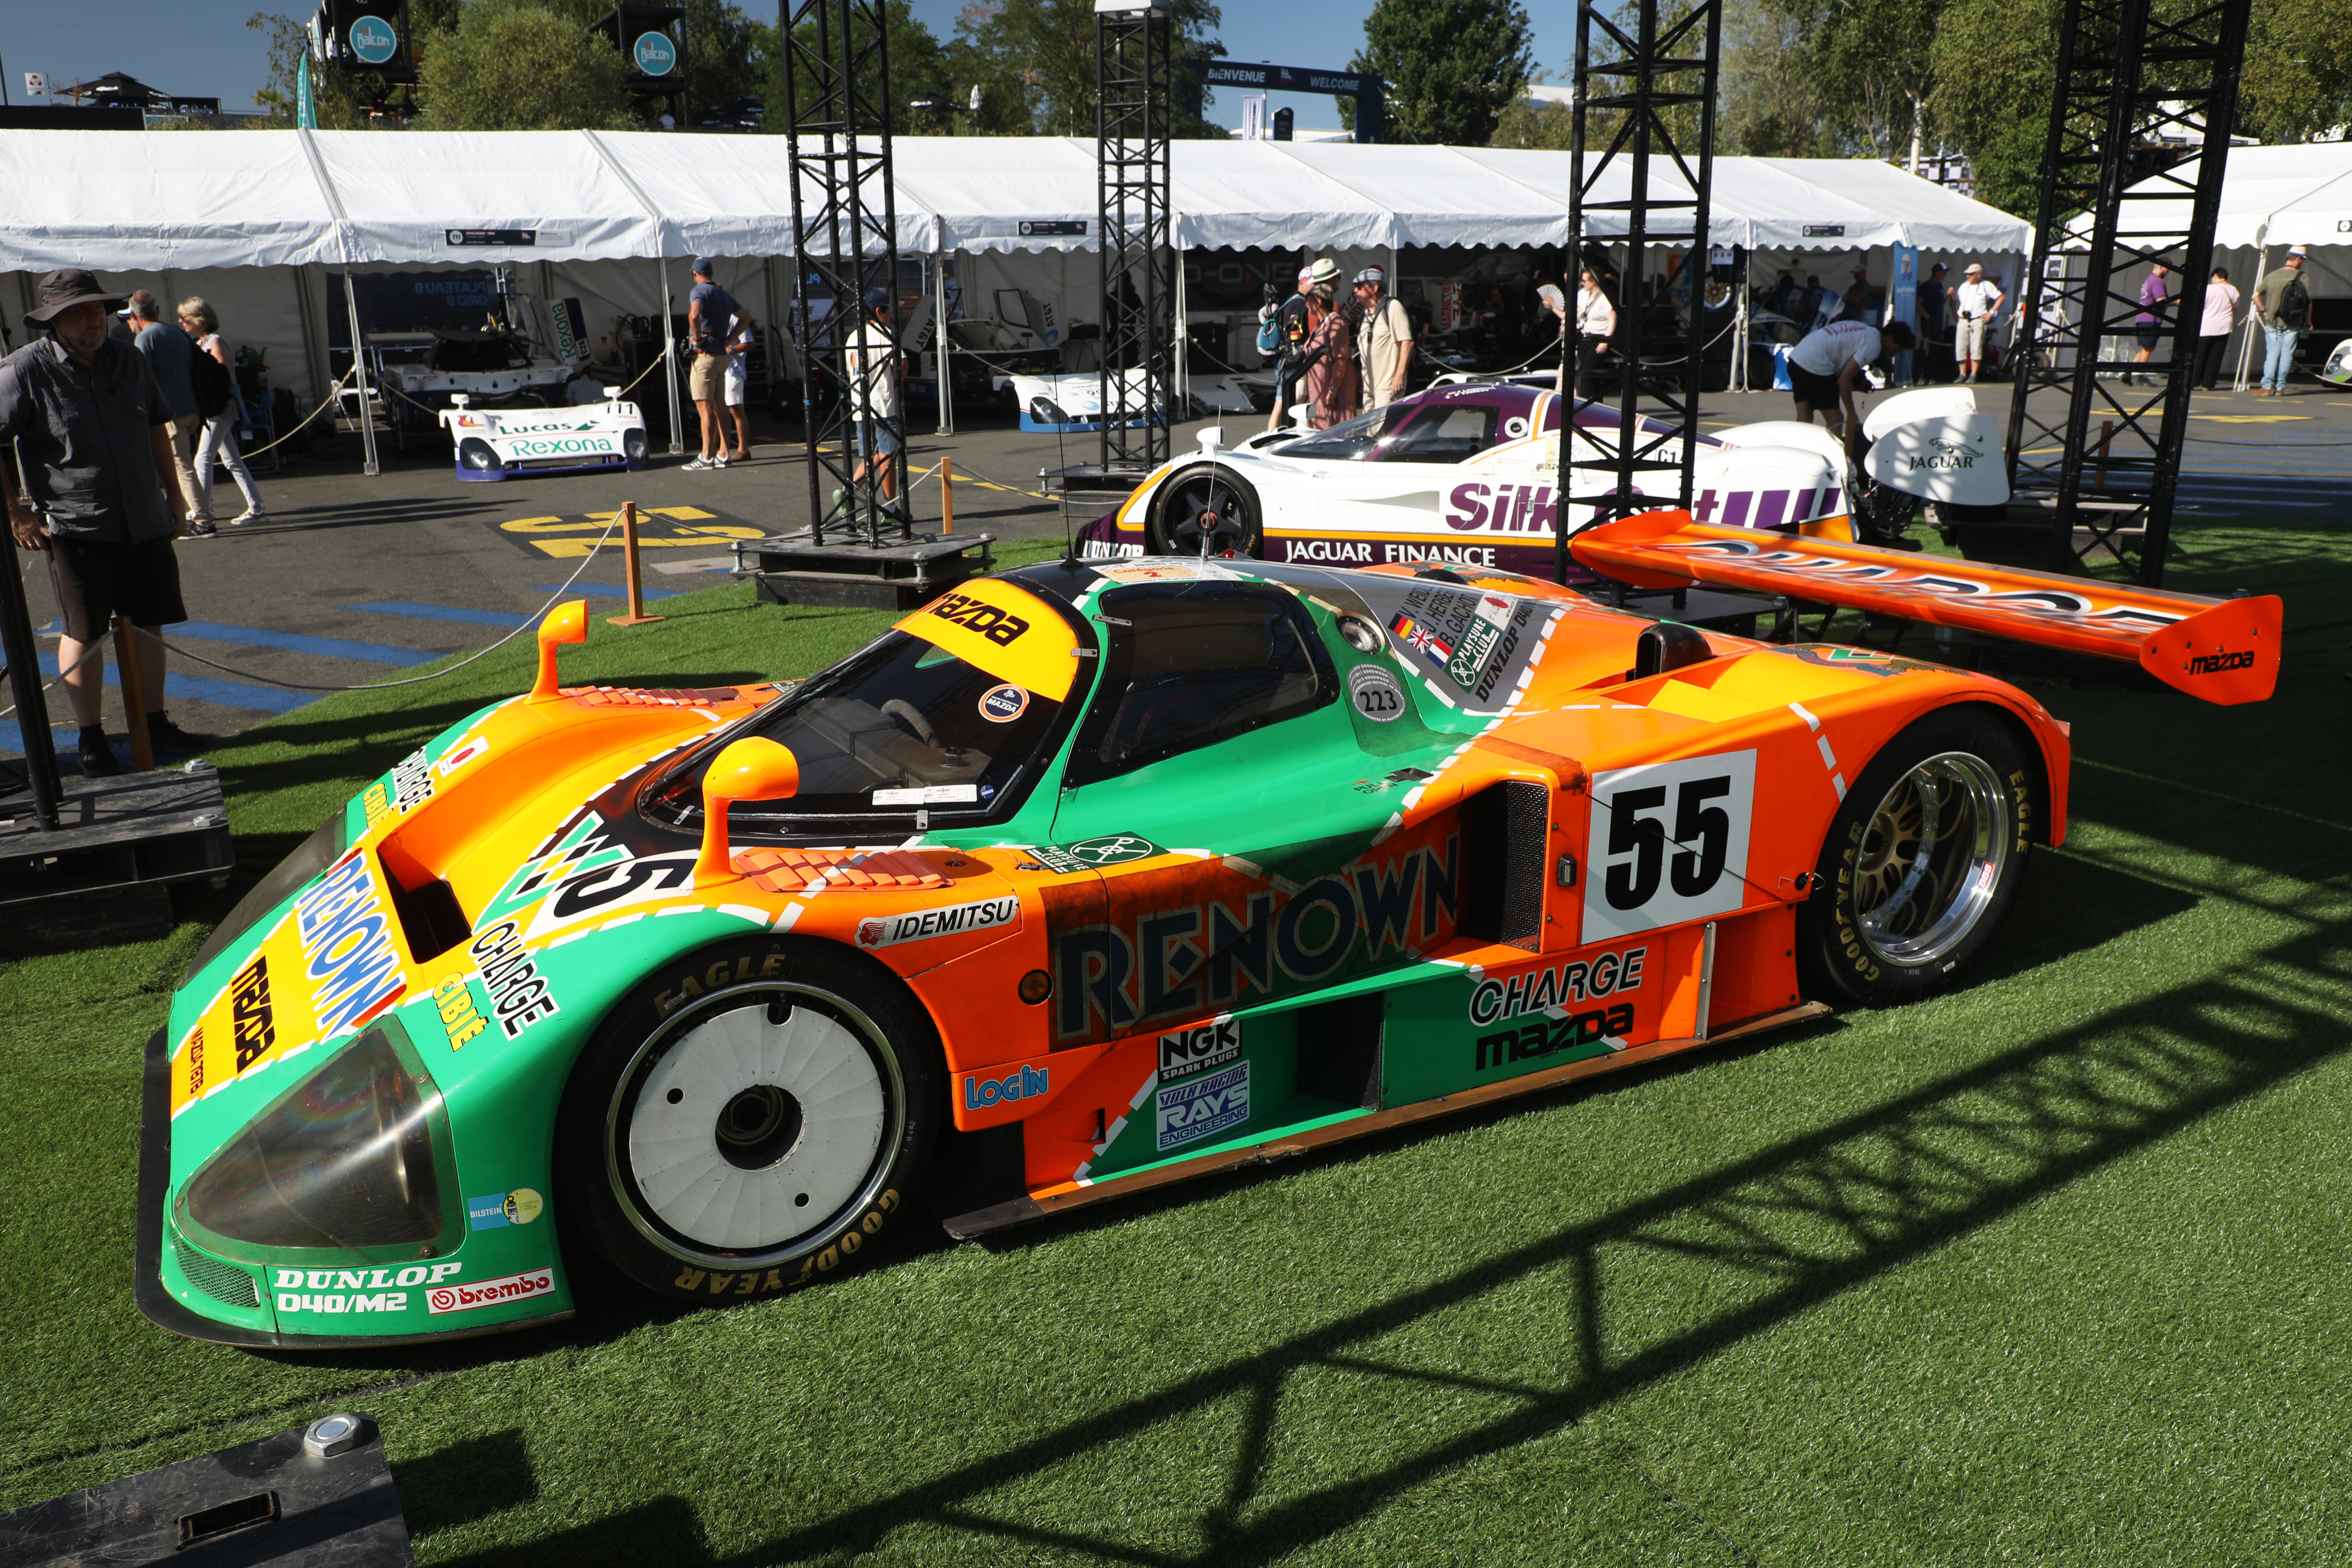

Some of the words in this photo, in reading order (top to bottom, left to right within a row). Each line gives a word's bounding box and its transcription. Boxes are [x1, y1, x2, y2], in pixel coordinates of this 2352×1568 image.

[1208, 68, 1266, 83] BIENVENUE
[1310, 76, 1360, 91] WELCOME
[551, 302, 576, 362] Rexona
[604, 403, 633, 415] 111
[499, 423, 572, 435] Lucas
[508, 438, 613, 456] Rexona
[1658, 449, 1683, 463] C1
[1909, 456, 1974, 471] JAGUAR
[1082, 539, 1145, 558] DUNLOP
[1285, 540, 1373, 564] JAGUAR
[1385, 543, 1496, 568] FINANCE
[1458, 618, 1486, 661] PLAYSURE
[1473, 633, 1491, 659] CLUB
[1361, 664, 1386, 673] GOODWOOD
[1363, 669, 1388, 678] GOODWOOD
[1364, 675, 1389, 683] GOODWOOD
[1475, 626, 1520, 703] DUNLOP
[1355, 681, 1372, 694] GOODWOOD
[1394, 688, 1404, 700] SPEED
[1359, 689, 1397, 712] 223
[986, 698, 1017, 713] MAZDA
[1361, 711, 1381, 722] PRESENTED
[1386, 708, 1404, 722] MASTERCARD
[390, 745, 436, 816] CHARGE
[2008, 769, 2031, 855] EAGLE
[1604, 774, 1732, 912] 55
[1041, 852, 1068, 867] CLUB
[1044, 846, 1090, 871] PLAYSURE
[1978, 862, 1994, 889] BBS
[1835, 821, 1880, 982] GOODYEAR
[893, 898, 1017, 943] IDEMITSU
[294, 849, 408, 1046] RENOWN
[1052, 831, 1463, 1043] RENOWN
[468, 919, 561, 1041] CHARGE
[653, 953, 786, 1020] EAGLE
[1468, 945, 1649, 1028] CHARGE
[190, 1027, 204, 1067] MAZDA
[1160, 1019, 1241, 1071] NGK
[190, 1060, 204, 1095] 787B
[1162, 1061, 1201, 1080] SPARK
[1204, 1048, 1238, 1068] PLUGS
[1198, 1065, 1248, 1096] RACING
[1161, 1083, 1248, 1134] RAYS
[1159, 1104, 1248, 1147] ENGINEERING
[470, 1207, 502, 1218] BILSTEIN
[674, 1188, 900, 1295] GOODYEAR
[273, 1261, 463, 1289] DUNLOP
[458, 1273, 550, 1305] brembo
[278, 1292, 408, 1314] D40/M2
